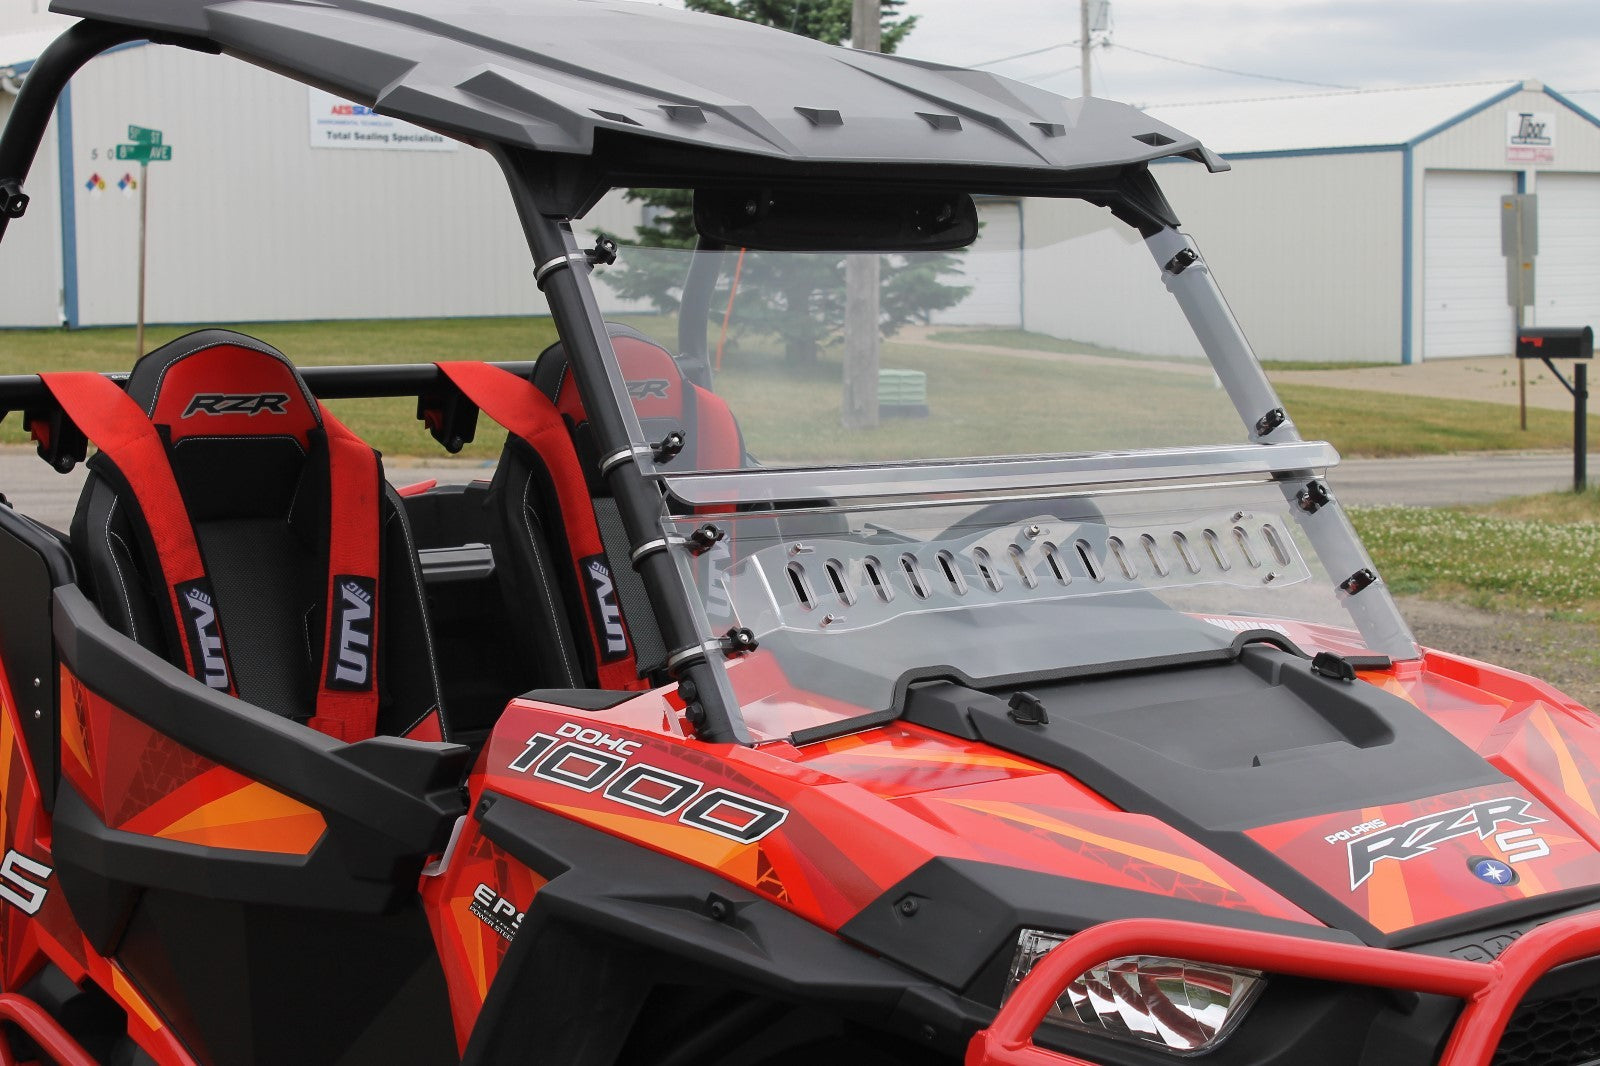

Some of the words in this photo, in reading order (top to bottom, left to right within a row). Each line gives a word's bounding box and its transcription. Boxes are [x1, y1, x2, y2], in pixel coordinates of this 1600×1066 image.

[150, 146, 168, 160] AVE
[151, 131, 161, 144] ST
[327, 131, 351, 140] Total
[354, 132, 389, 142] Sealing
[392, 133, 443, 143] Specialists
[181, 393, 291, 419] RZR
[625, 378, 670, 401] ZR
[587, 565, 627, 653] UTV
[185, 591, 229, 688] UTV
[335, 583, 371, 685] UTV
[555, 721, 642, 756] DOHC
[508, 732, 790, 845] 1000
[1324, 818, 1387, 845] POLARIS
[1347, 797, 1549, 891] RZR
[1495, 828, 1550, 863] S
[469, 905, 494, 927] POWER
[494, 925, 514, 942] STEE
